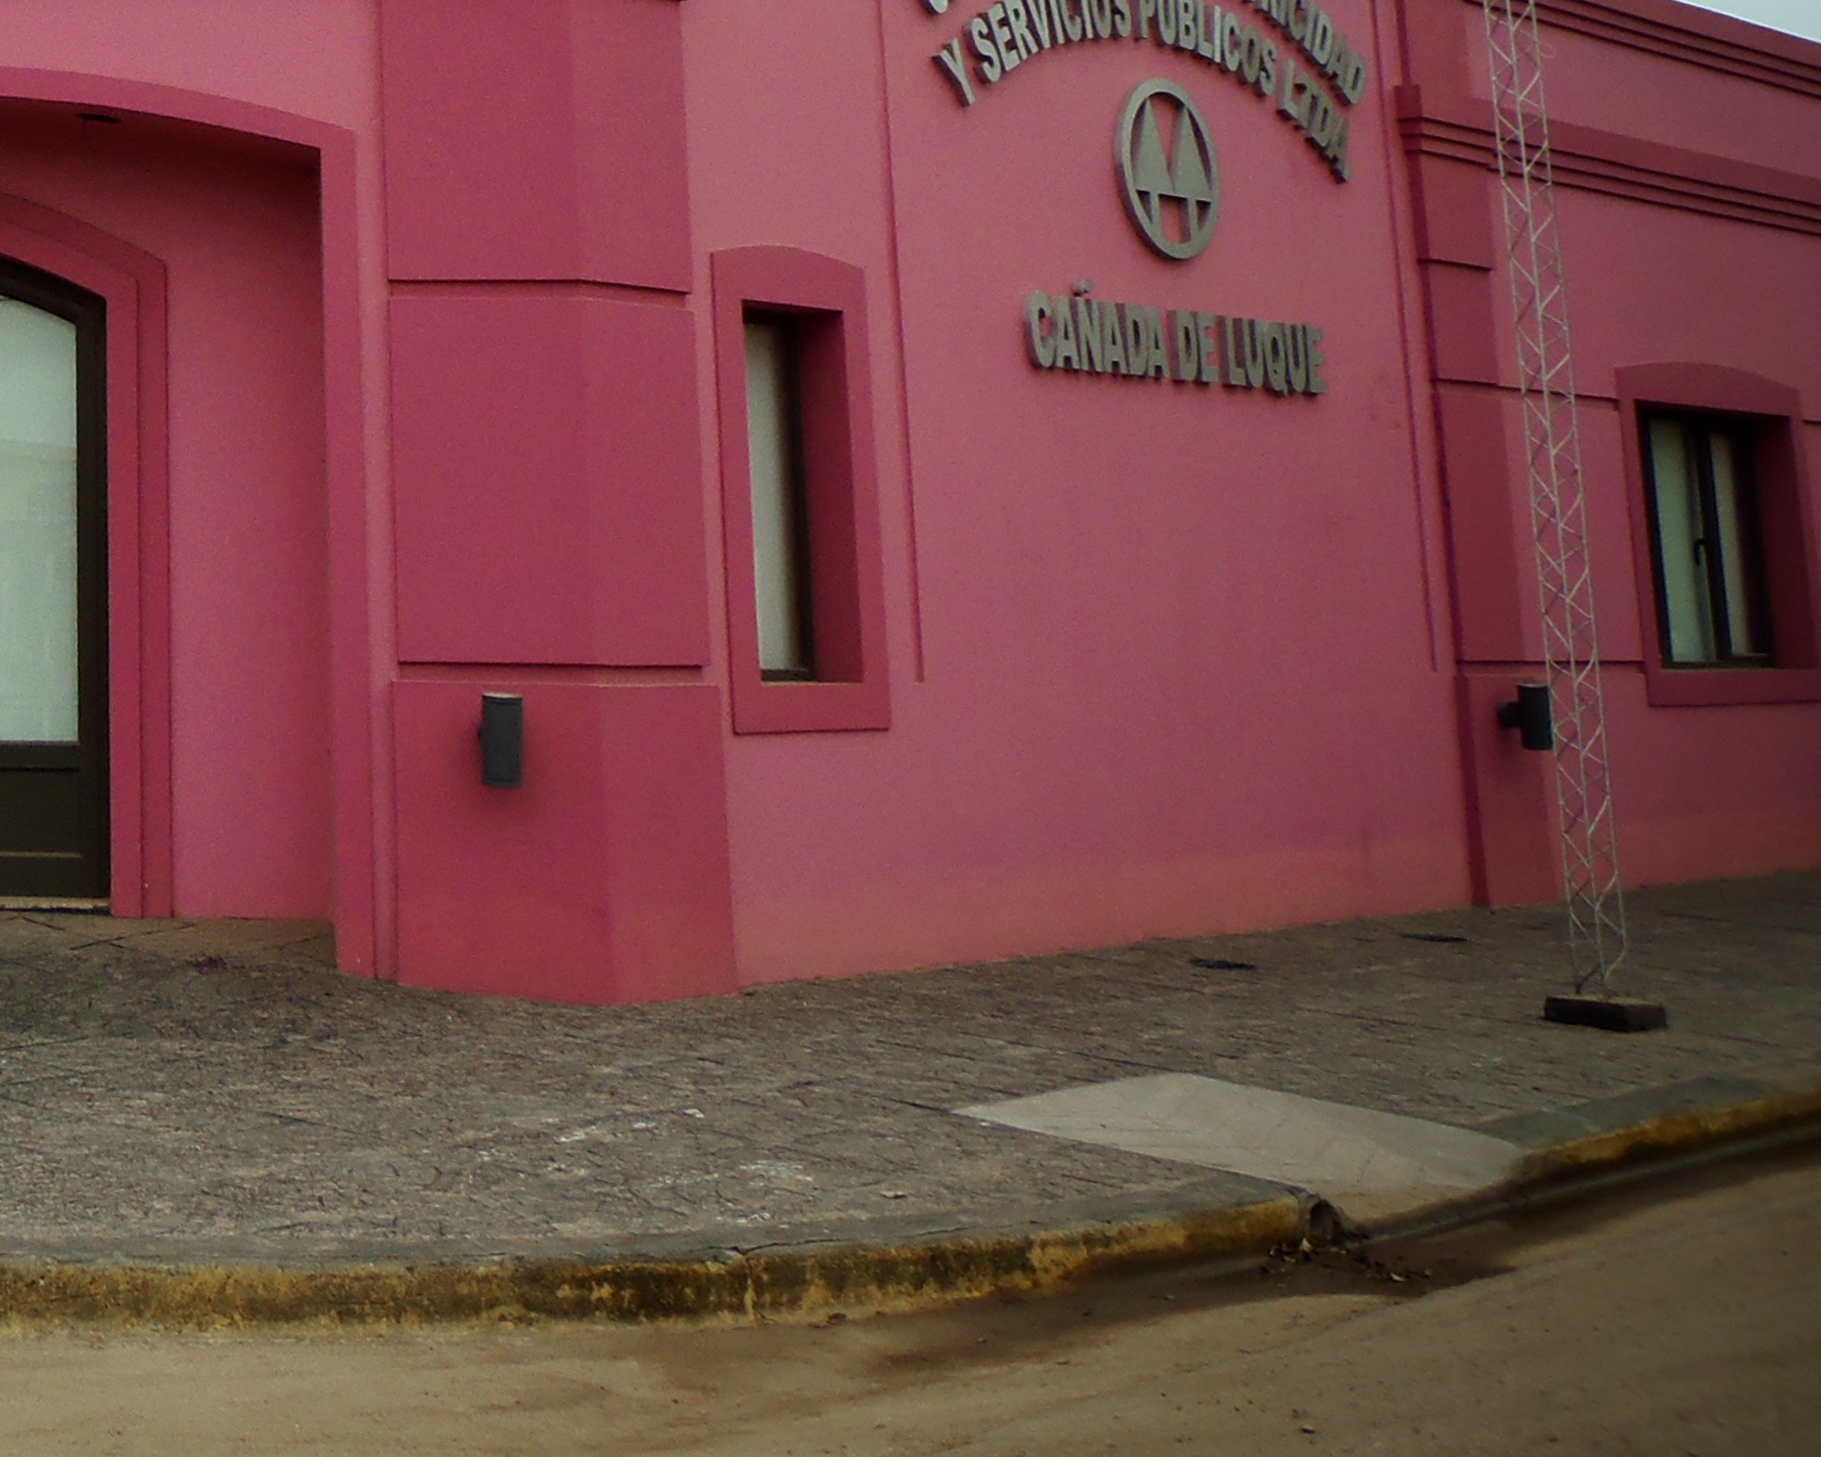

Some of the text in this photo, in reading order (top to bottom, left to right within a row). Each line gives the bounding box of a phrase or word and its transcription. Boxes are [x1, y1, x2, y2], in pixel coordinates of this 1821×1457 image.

[932, 38, 976, 106] Y
[1278, 58, 1352, 182] LTDA
[1023, 279, 1327, 395] CAÑADA DE LUQUE
